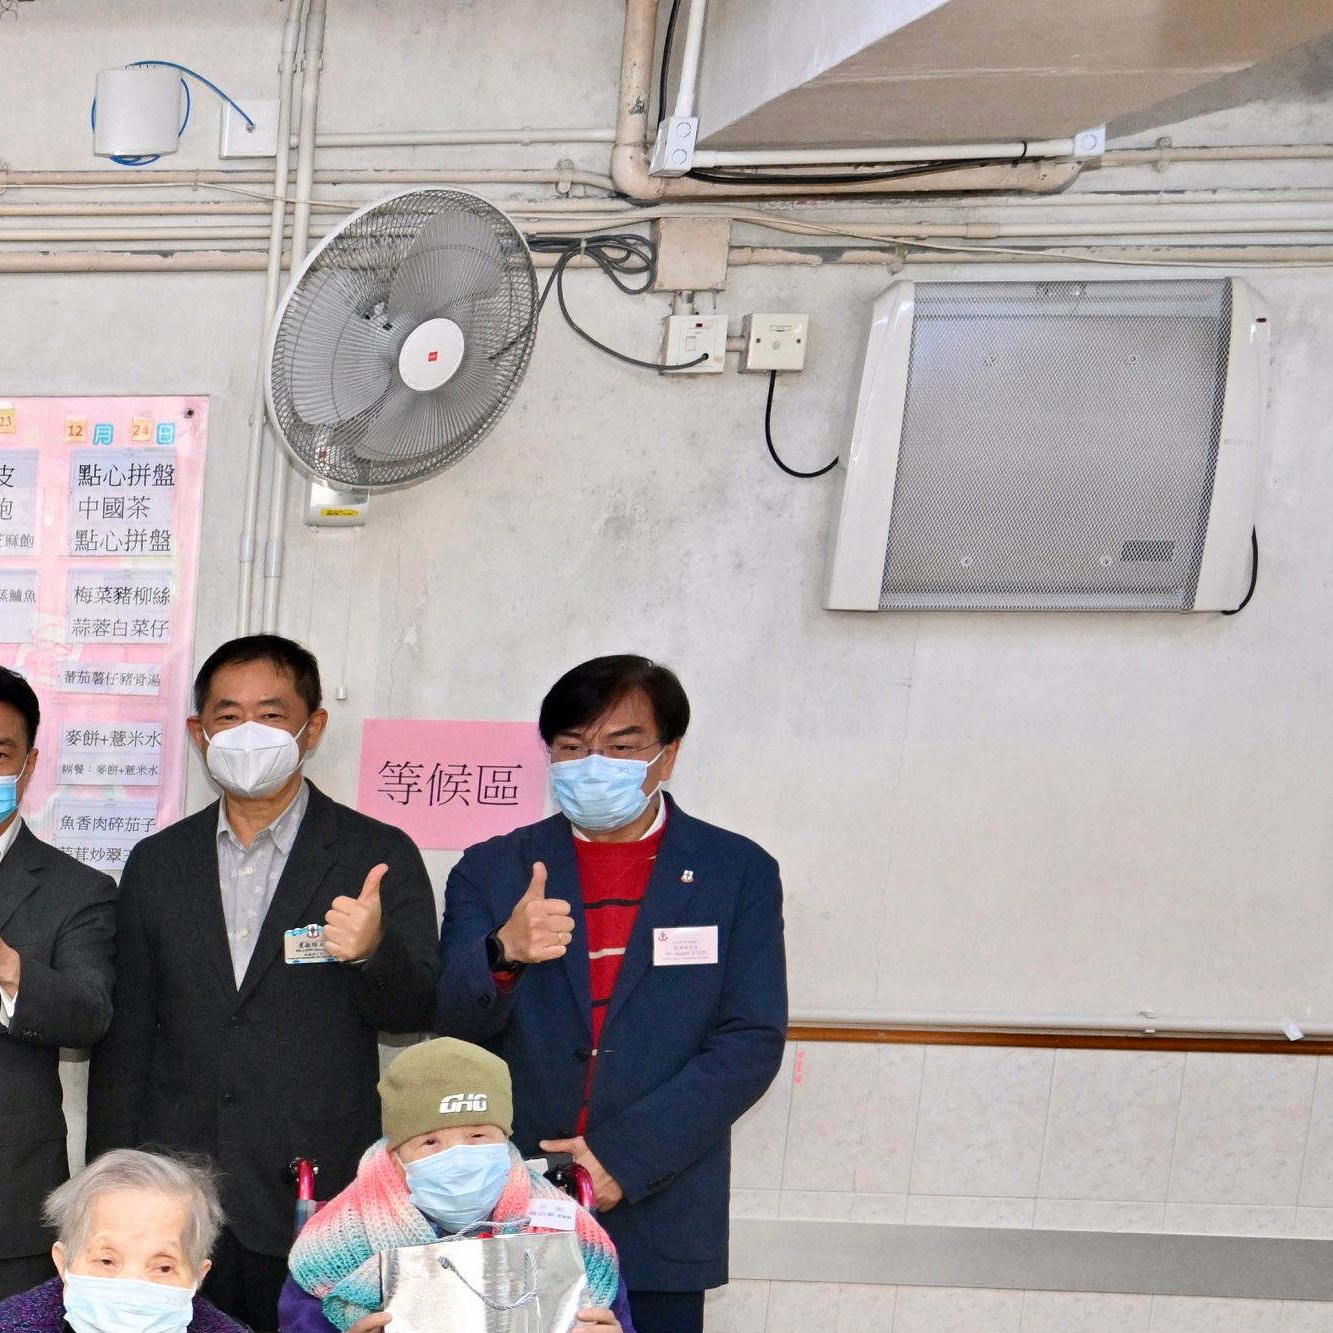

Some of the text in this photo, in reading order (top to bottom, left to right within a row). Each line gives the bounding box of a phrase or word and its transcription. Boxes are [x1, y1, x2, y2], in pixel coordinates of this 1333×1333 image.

[78, 463, 176, 487] 點心拼盤
[78, 496, 151, 520] 中國茶
[75, 529, 172, 553] 點心拼盤
[74, 586, 170, 605] 梅菜豬柳絲
[72, 618, 169, 637] 蒜蓉白菜仔
[65, 731, 161, 748] 麥餅+薏米水
[377, 760, 523, 807] 等候區
[59, 815, 156, 832] 魚香肉碎茄子
